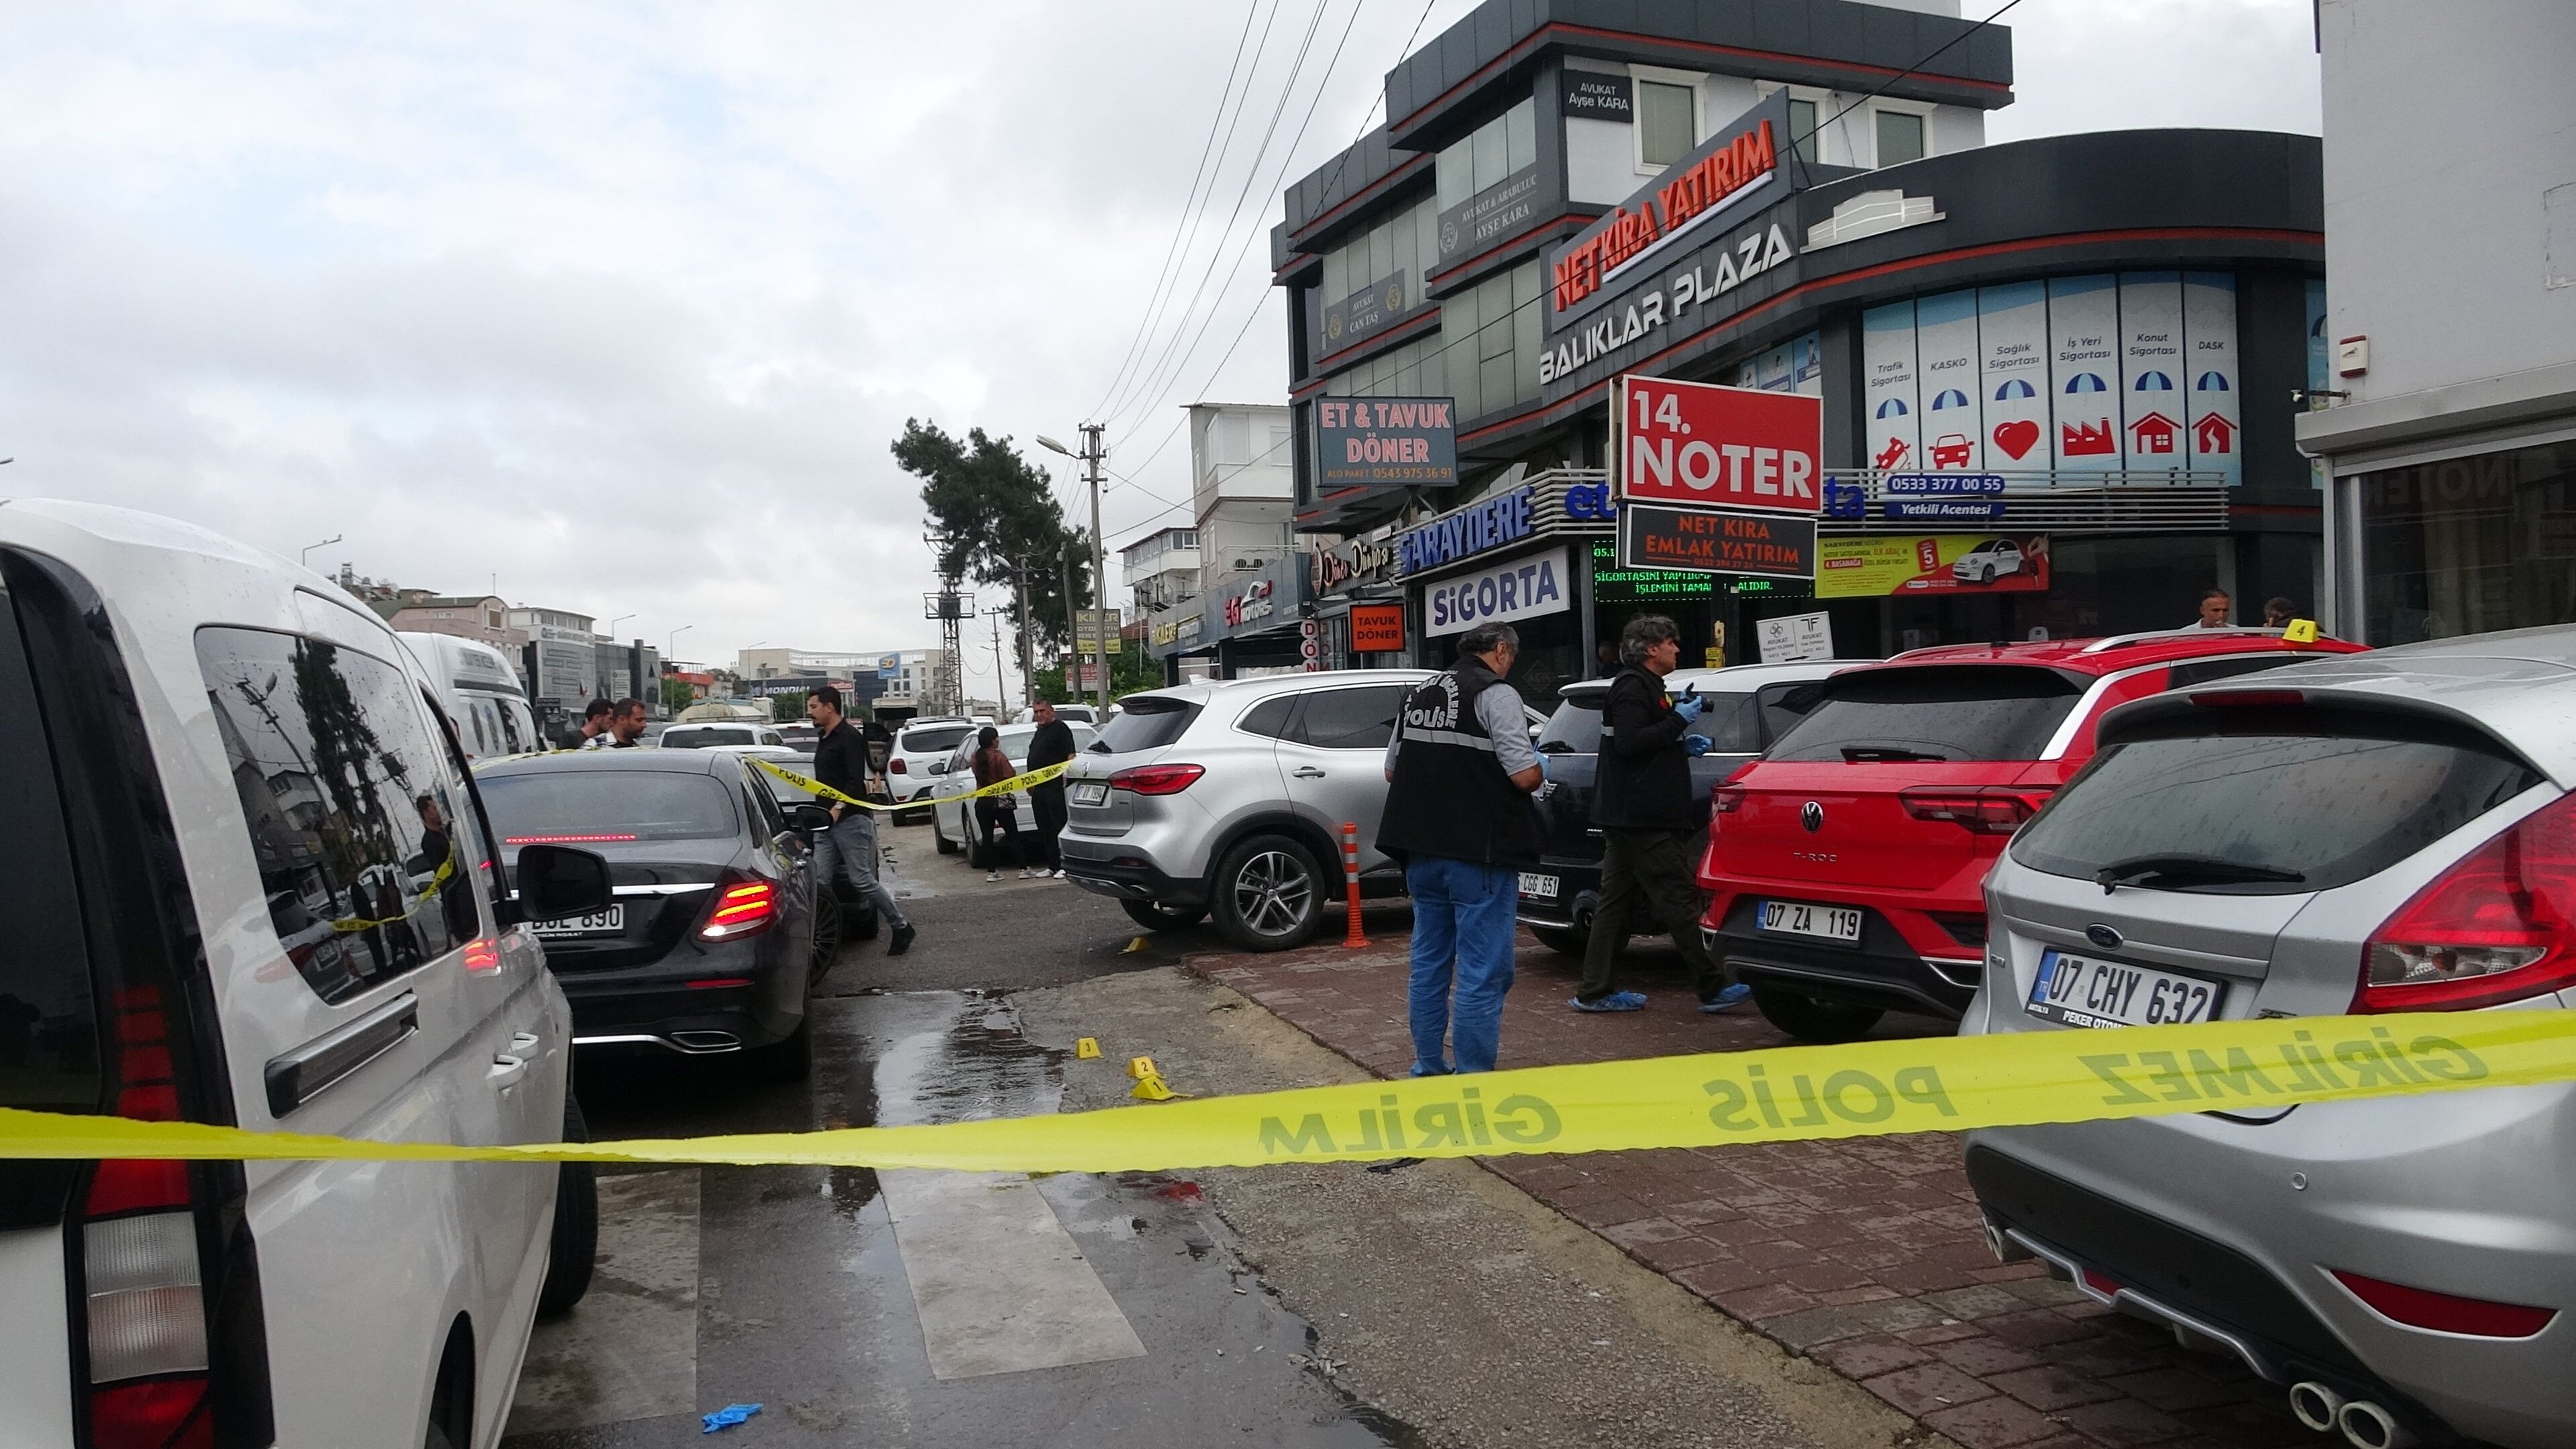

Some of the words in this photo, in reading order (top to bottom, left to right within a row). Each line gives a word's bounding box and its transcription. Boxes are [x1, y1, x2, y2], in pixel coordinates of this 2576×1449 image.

[1580, 83, 1616, 95] AVUKAT
[1569, 93, 1594, 107] Ayşe
[1598, 96, 1629, 110] KARA
[1461, 200, 1489, 223] AVUKAT
[1554, 236, 1603, 312] NET
[1657, 119, 1777, 231] YATIRIM
[1476, 218, 1500, 240] AYŞE
[1501, 203, 1529, 227] KARA
[1540, 290, 1665, 386] BALIKLAR
[1674, 223, 1793, 317] PLAZA
[1350, 319, 1364, 333] CAN
[2068, 337, 2077, 347] İş
[2081, 336, 2101, 346] Yeri
[2137, 333, 2168, 342] Konut
[1996, 343, 2031, 356] Sağlık
[2129, 347, 2177, 356] Sigortası
[2198, 341, 2224, 350] DASK
[2059, 350, 2110, 362] Sigortası
[1878, 361, 1904, 373] Trafik
[1930, 358, 1968, 371] KASKO
[1989, 357, 2039, 369] Sigortası
[1871, 374, 1911, 387] Sigortası
[1321, 403, 1350, 428] ET
[1354, 403, 1371, 428] &
[1375, 404, 1450, 428] TAVUK
[1633, 390, 1692, 435] 14.
[1346, 432, 1430, 463] DÖNER
[1633, 435, 1813, 498] NOTER
[1892, 478, 1927, 490] 0533
[1931, 478, 1956, 490] 377
[1962, 478, 1979, 490] 00
[1984, 478, 2001, 490] 55
[1901, 504, 1939, 515] Yetkili
[1940, 504, 1992, 515] Acentesi
[1399, 484, 1536, 577] SARAYDERE
[1679, 516, 1718, 535] NET
[1725, 516, 1771, 539] KİRA
[1646, 535, 1715, 557] EMLAK
[1721, 541, 1799, 564] YATIRIM
[1923, 549, 1933, 564] 5
[1595, 571, 1660, 582] SİGORTASINI
[1635, 582, 1679, 594] İŞLEMİNİ
[1357, 616, 1396, 626] TAVUK
[1357, 628, 1398, 640] DÖNER
[2296, 625, 2306, 636] 4
[1793, 852, 1837, 862] T-ROC
[1542, 877, 1557, 895] 651
[1766, 904, 1785, 927] 07
[1792, 907, 1811, 931] ZA
[1829, 911, 1858, 936] 119
[2049, 958, 2084, 1002] 07
[2086, 965, 2142, 1017] CHY
[2147, 979, 2208, 1024] 632
[2062, 1010, 2092, 1027] PEKER
[2093, 1018, 2129, 1029] OTO
[1085, 1042, 1091, 1052] 3
[1141, 1061, 1148, 1071] 2
[1152, 1081, 1162, 1091] 1
